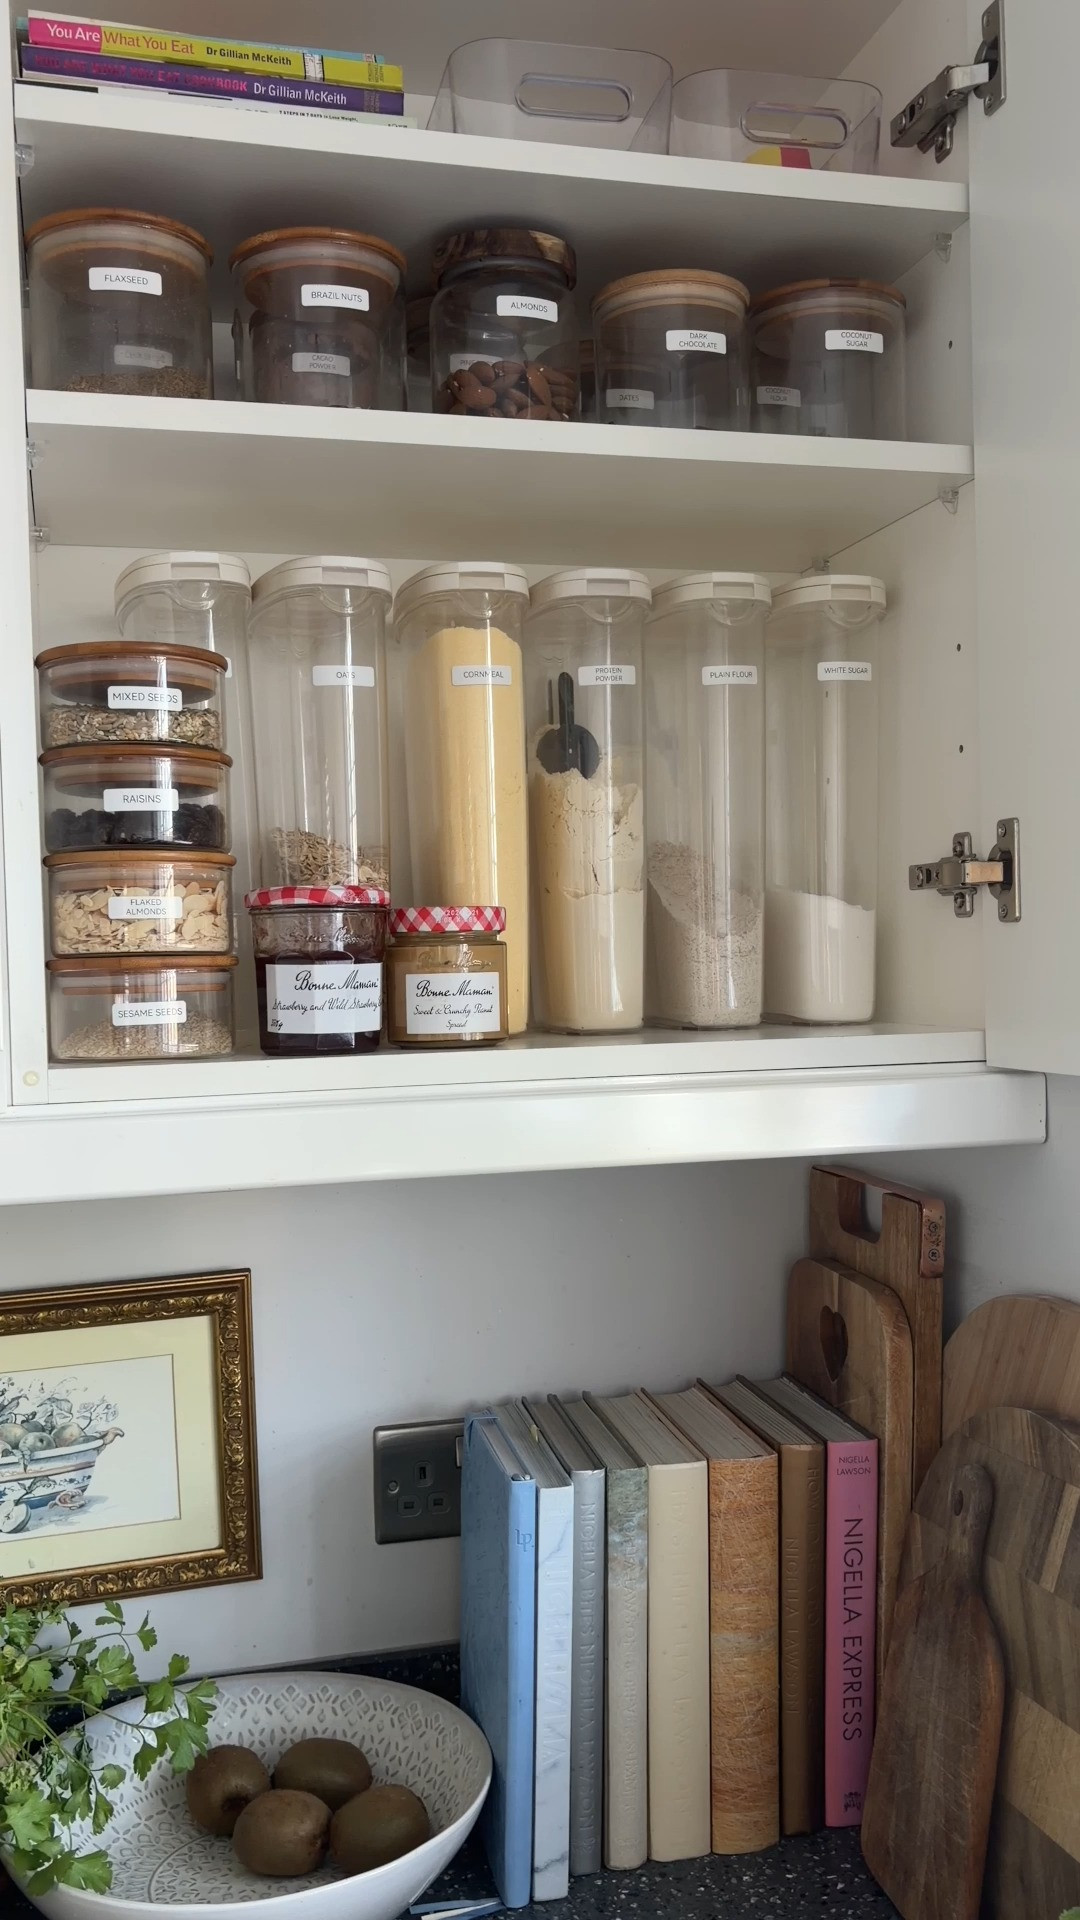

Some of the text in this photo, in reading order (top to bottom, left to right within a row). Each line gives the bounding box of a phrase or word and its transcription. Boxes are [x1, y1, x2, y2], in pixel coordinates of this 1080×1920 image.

[47, 23, 292, 66] You Are What You Eat Dr Gillian McKeith
[158, 70, 180, 82] EAT
[253, 82, 266, 95] Dr
[268, 84, 302, 99] Gillian
[304, 88, 347, 105] McKeith
[104, 274, 149, 286] FLAXSEED
[311, 291, 363, 303] BRAZIL NUTS
[510, 301, 548, 313] ALMONDS
[689, 332, 708, 340] DARK
[840, 331, 872, 340] COCONUT
[678, 340, 718, 350] CHOCOLATE
[846, 339, 868, 348] SUGAR
[311, 354, 334, 362] CACAO
[309, 362, 336, 370] POWDER
[619, 394, 640, 402] DATES
[336, 671, 356, 679] OATS
[710, 670, 753, 679] PLAIN FLOUR
[824, 666, 847, 674] WHITE
[112, 691, 178, 704] MIXED SEEDS
[123, 793, 162, 804] RAISINS
[130, 898, 162, 907] FLAKED
[125, 906, 167, 916] ALMONDS
[294, 969, 378, 992] Bonne Maman
[415, 979, 491, 998] Bonne Maman
[271, 998, 308, 1015] Strawberry
[309, 1000, 327, 1012] and
[328, 997, 349, 1011] Wild
[413, 1003, 434, 1016] Sweet
[443, 1003, 471, 1017] Crunchy
[118, 1007, 183, 1018] SESAME SEEDS
[445, 1019, 467, 1029] Spread
[838, 1455, 870, 1465] NIGELLA
[836, 1467, 871, 1476] LAWSON
[785, 1537, 800, 1714] NIGELLA LAWSON
[842, 1517, 864, 1742] NIGELLA EXPRESS
[579, 1502, 597, 1831] NIGELLA BITES NIGELLA LAWSON
